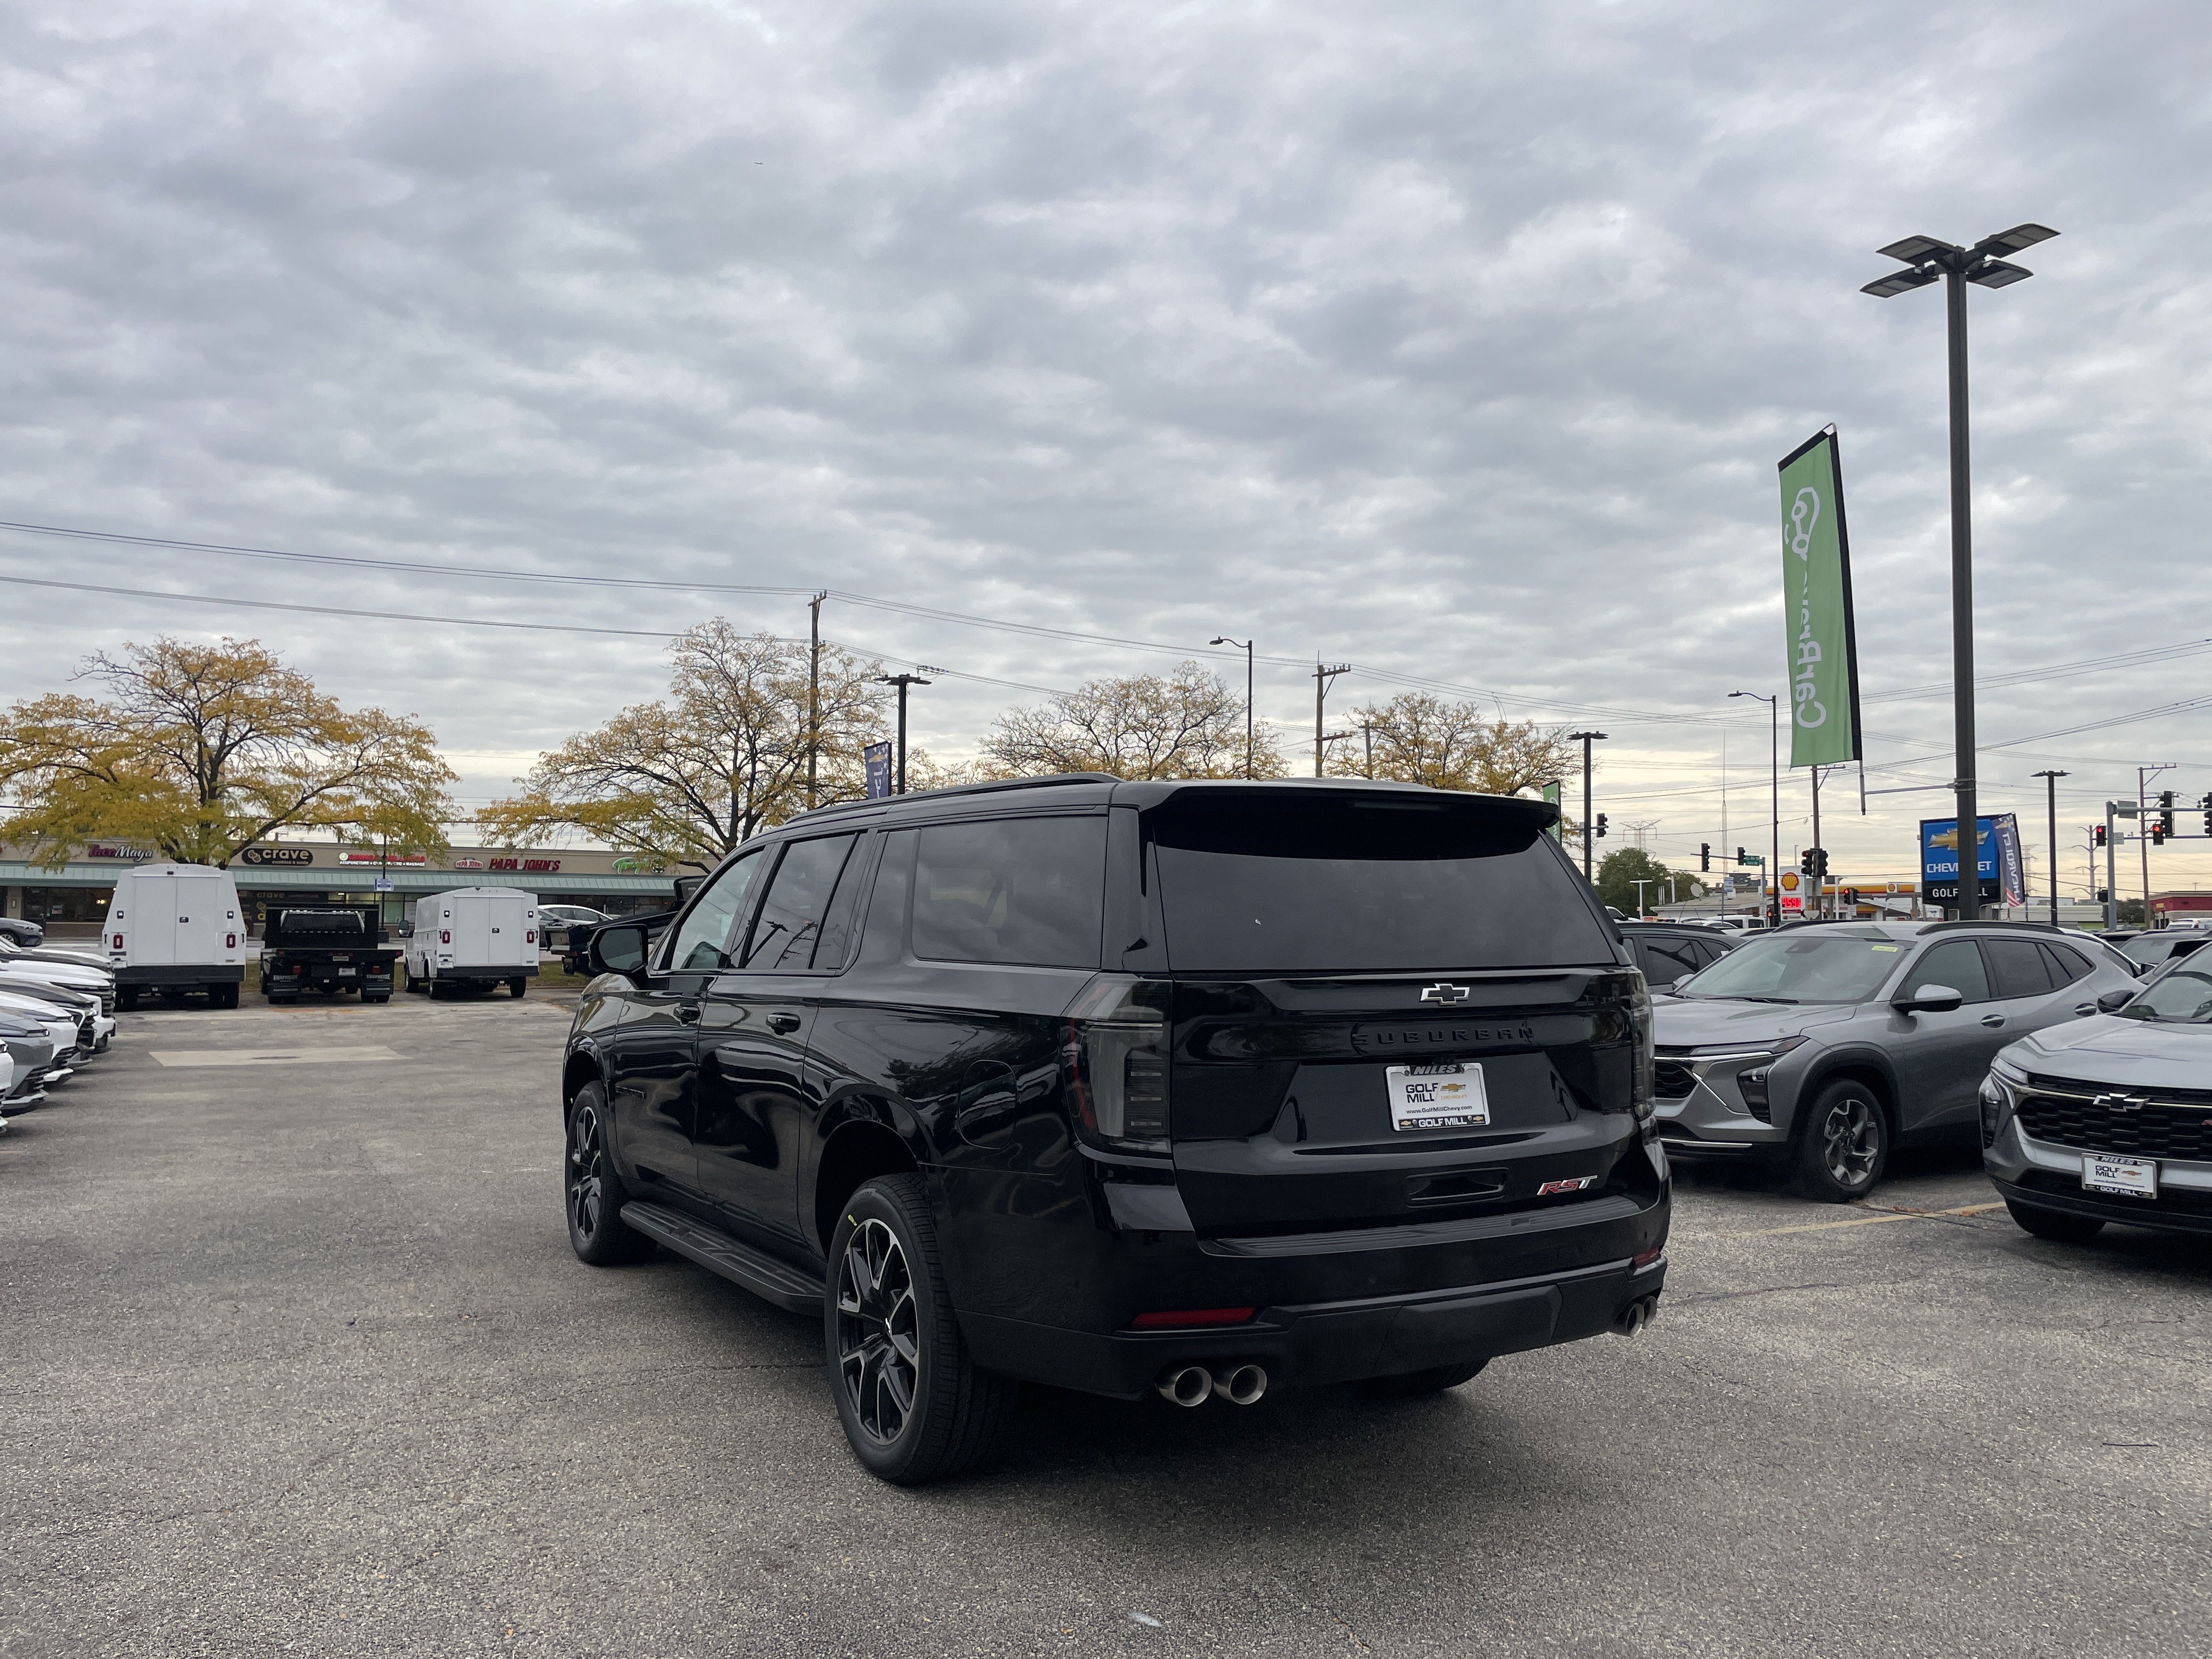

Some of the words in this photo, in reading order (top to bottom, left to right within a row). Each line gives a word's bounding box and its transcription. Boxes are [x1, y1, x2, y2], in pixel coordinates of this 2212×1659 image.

[262, 849, 309, 860] crave
[489, 858, 518, 870] PAPA
[522, 859, 561, 871] JOHN'S
[1926, 861, 1993, 873] CHEVET
[1932, 888, 1959, 898] GOLF
[1351, 1027, 1534, 1046] SUBURBAN
[1413, 1064, 1457, 1075] NILES
[1406, 1082, 1439, 1093] GOLF
[1406, 1092, 1435, 1104] MILL
[1406, 1105, 1473, 1114] www.GolfMillChevy.com
[1418, 1118, 1444, 1128] GOLF
[1444, 1116, 1468, 1126] MILL
[1537, 1175, 1598, 1195] RST
